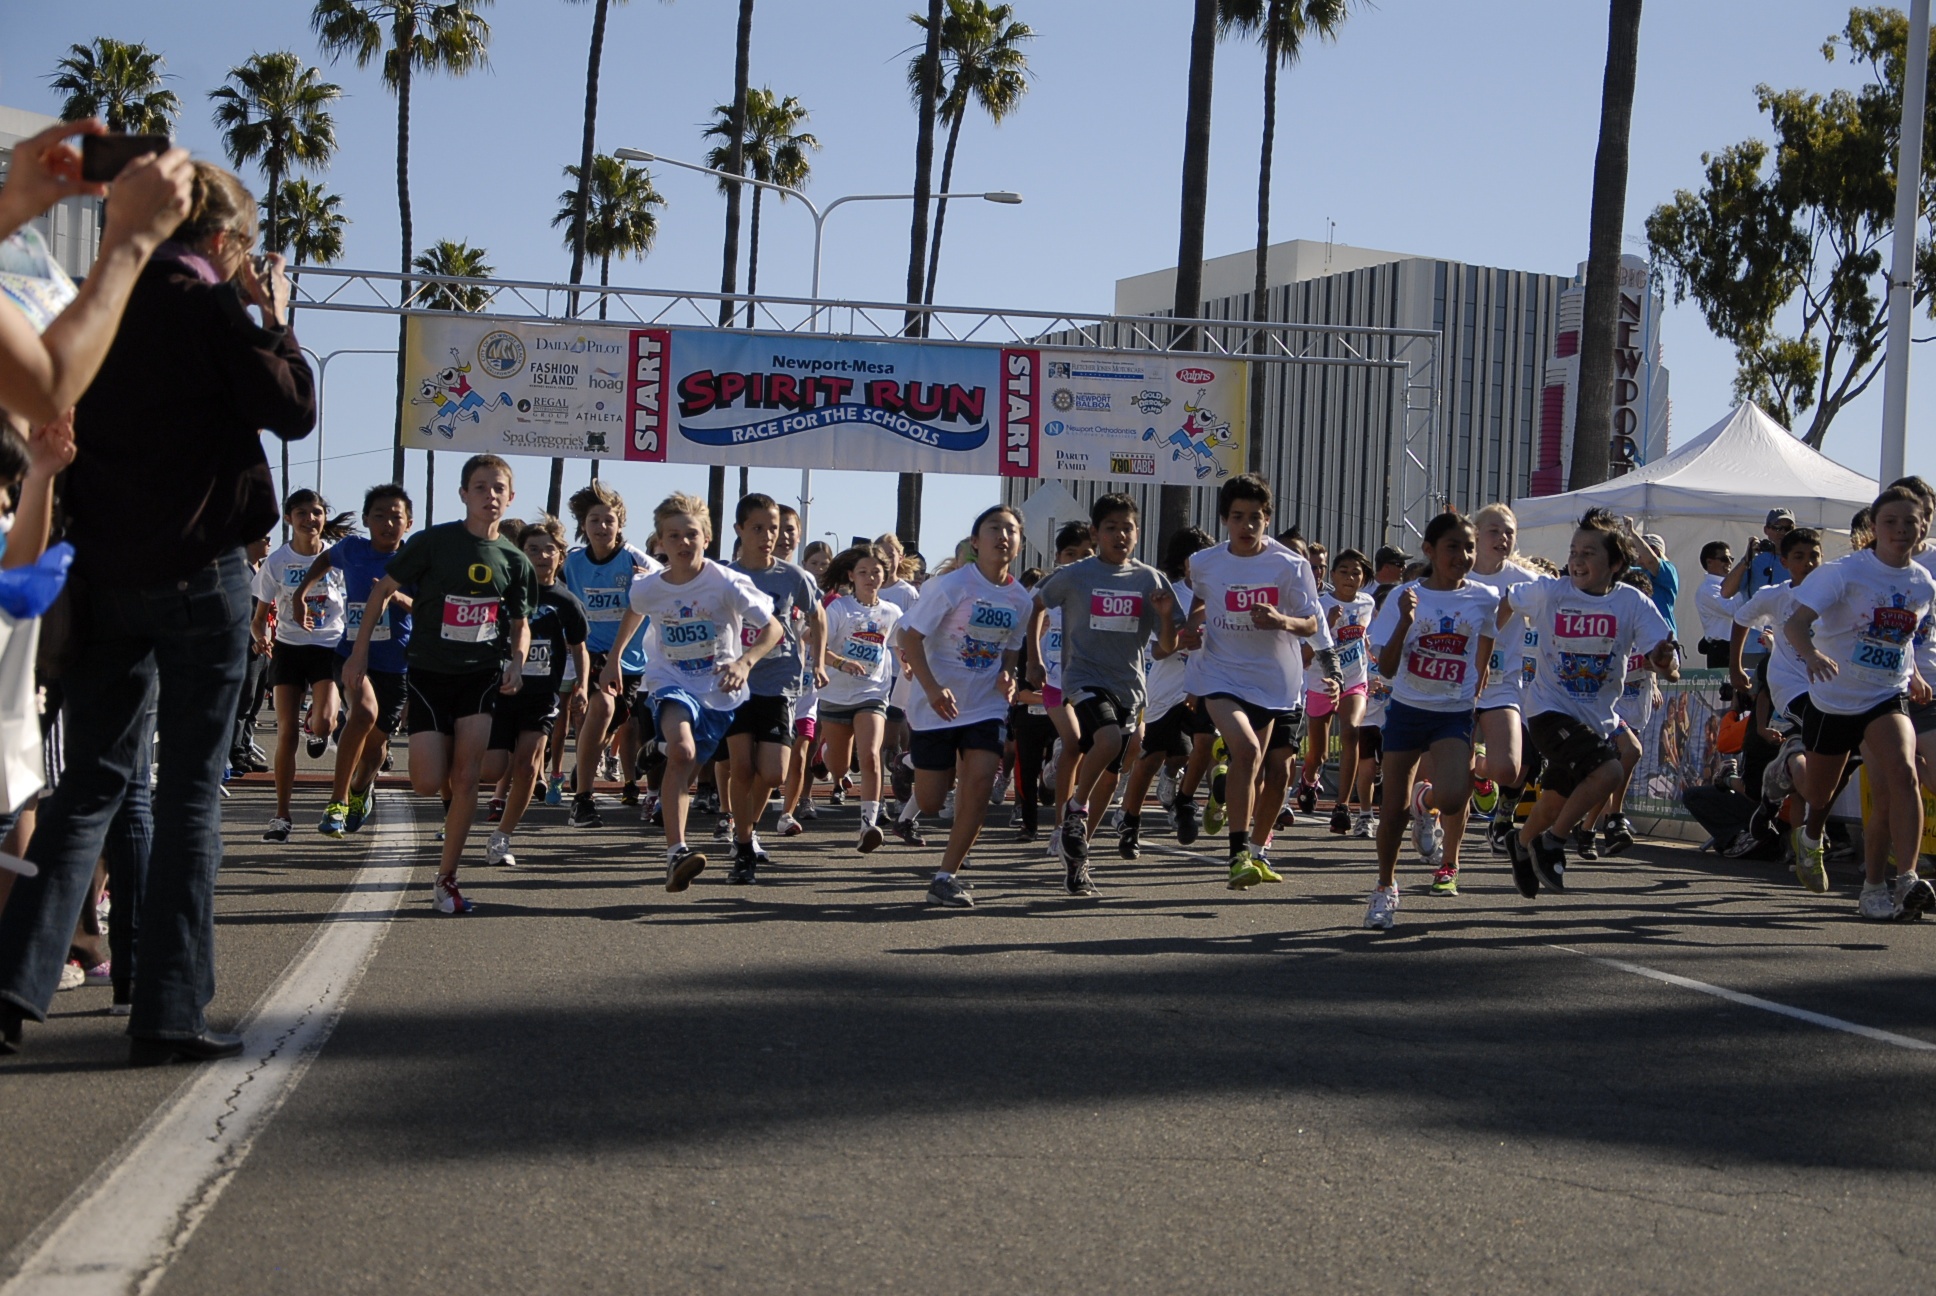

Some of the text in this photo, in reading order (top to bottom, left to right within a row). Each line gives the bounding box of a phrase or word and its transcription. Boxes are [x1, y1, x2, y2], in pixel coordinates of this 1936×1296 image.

[1619, 268, 1647, 289] BIG
[536, 338, 622, 355] DAILY PILOT
[530, 362, 579, 375] FASHION
[773, 355, 895, 374] Newport-Mesa
[533, 374, 575, 386] ISLAND
[589, 375, 624, 394] hoag
[1179, 370, 1211, 382] Ralphs
[533, 397, 568, 408] REGAL
[634, 336, 662, 454] START
[677, 370, 854, 417] SPIRIT
[864, 379, 986, 425] RUN
[1141, 390, 1162, 400] GOLD
[1008, 353, 1032, 469] START
[1075, 401, 1111, 409] BALBOA
[1141, 406, 1161, 415] CAMP
[575, 412, 623, 423] ATHLETA
[732, 407, 940, 446] RACE FOR THE SCHOOLS
[502, 430, 524, 446] Spa
[1049, 423, 1137, 435] N Newport Orthodontics
[1056, 450, 1089, 461] DARUTY
[1057, 460, 1086, 471] FAMILY
[1112, 459, 1154, 474] 790 KABC
[468, 563, 492, 583] O
[588, 594, 621, 608] 2974
[1102, 597, 1133, 615] 908
[1237, 591, 1269, 609] 910
[457, 605, 490, 624] 848
[976, 607, 1012, 628] 2893
[1880, 611, 1914, 623] SPIRIT
[666, 625, 709, 643] 3053
[1563, 615, 1609, 636] 1410
[1425, 638, 1466, 647] SPIRIT
[847, 643, 879, 663] 2927
[1859, 645, 1901, 670] 2838
[1417, 657, 1460, 681] 1413
